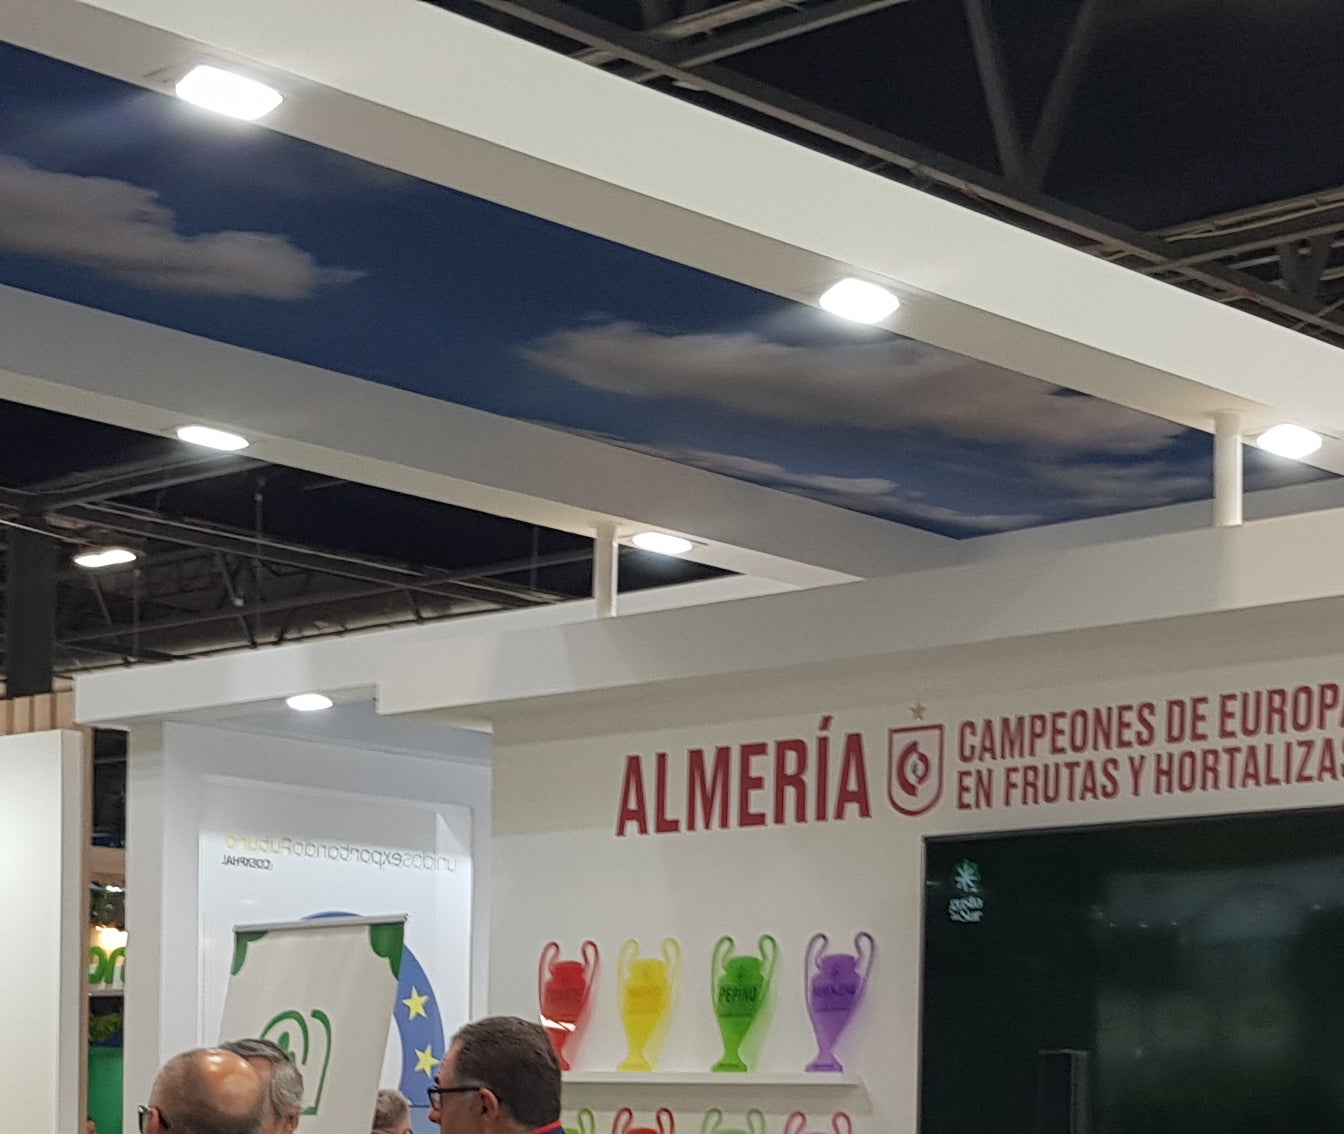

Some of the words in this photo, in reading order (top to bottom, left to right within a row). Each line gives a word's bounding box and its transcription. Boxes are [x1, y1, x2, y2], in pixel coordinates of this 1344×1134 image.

[958, 702, 1156, 764] CAMPEONES
[1165, 696, 1210, 744] DE
[616, 715, 872, 837] ALMERÍA
[957, 768, 994, 810] EN
[1003, 757, 1120, 806] FRUTAS
[1127, 754, 1147, 797] Y
